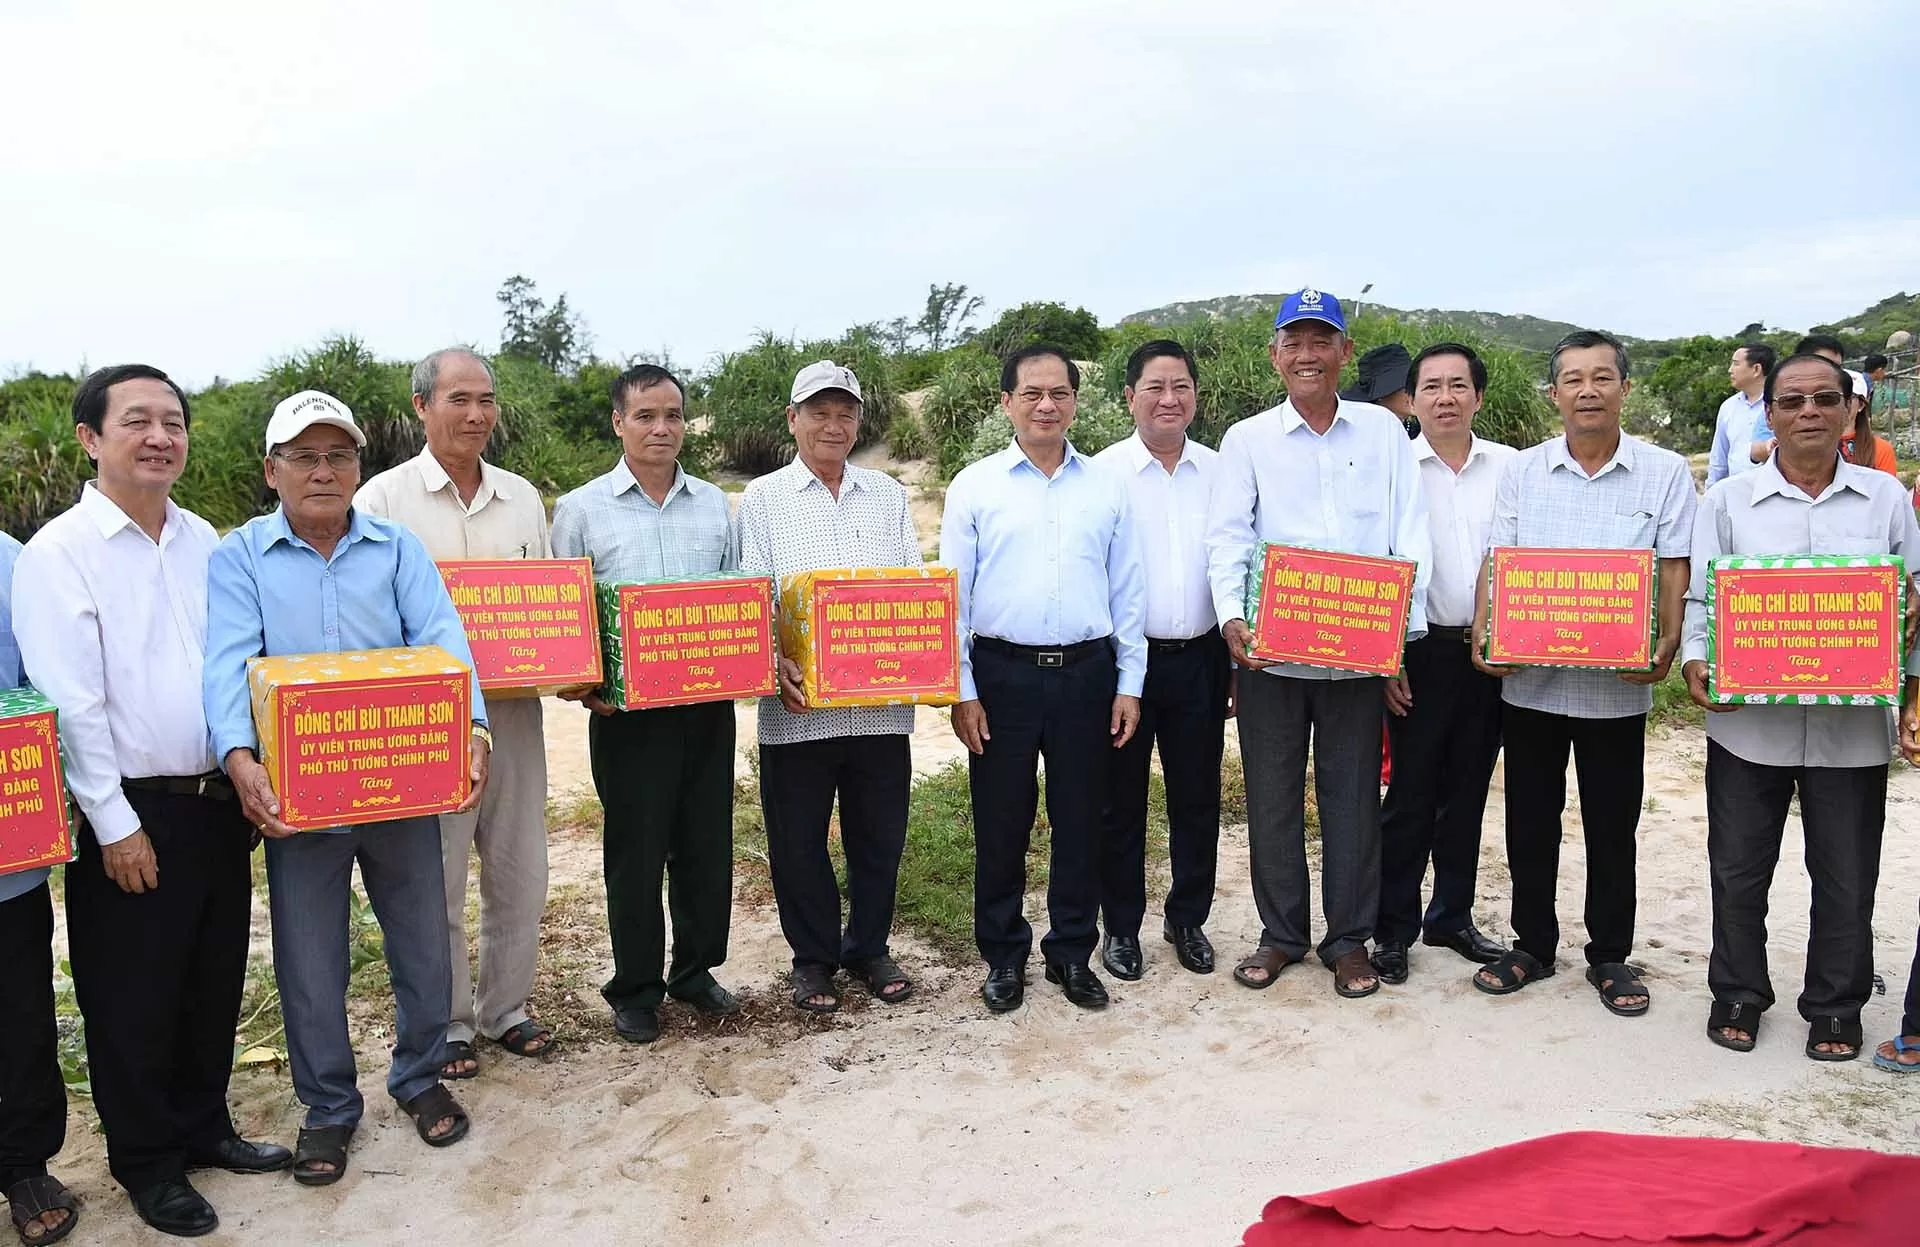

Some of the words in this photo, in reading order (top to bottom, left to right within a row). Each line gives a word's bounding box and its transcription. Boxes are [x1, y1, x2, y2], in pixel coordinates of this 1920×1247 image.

[1304, 570, 1323, 591] CHÍ
[1323, 573, 1341, 594] BÙI
[1343, 577, 1377, 598] THANH
[1378, 581, 1400, 601] SƠN
[1536, 567, 1555, 590] CHÍ
[1557, 567, 1575, 591] BÙI
[1577, 571, 1613, 591] THANH
[1615, 571, 1640, 591] SƠN
[483, 582, 501, 605] CHÍ
[503, 582, 522, 605] BÙI
[523, 584, 558, 604] THANH
[560, 582, 581, 603] SƠN
[1276, 590, 1288, 604] ỦY
[1289, 594, 1310, 607] VIÊN
[1311, 597, 1341, 610] TRUNG
[1342, 601, 1366, 614] ƯƠNG
[1367, 603, 1392, 617] ĐẢNG
[1508, 591, 1521, 605] ỦY
[1522, 592, 1544, 606] VIÊN
[1546, 595, 1577, 607] TRUNG
[1579, 595, 1605, 608] ƯƠNG
[1607, 594, 1633, 609] ĐẢNG
[1765, 589, 1786, 613] CHÍ
[1789, 588, 1810, 613] BÙI
[1813, 592, 1854, 612] THANH
[1857, 590, 1883, 612] SƠN
[473, 609, 494, 624] VIÊN
[496, 609, 527, 622] TRUNG
[529, 609, 553, 621] ƯƠNG
[555, 607, 579, 621] ĐẢNG
[665, 603, 683, 627] CHÍ
[685, 602, 703, 625] BÙI
[705, 603, 739, 621] THANH
[740, 600, 761, 621] SƠN
[855, 598, 873, 621] CHÍ
[874, 599, 891, 620] BÙI
[892, 600, 924, 620] THANH
[925, 599, 945, 619] SƠN
[1506, 609, 1526, 622] PHÓ
[1528, 608, 1546, 622] THỦ
[1549, 610, 1580, 623] TƯỚNG
[1582, 610, 1612, 623] CHÍNH
[1614, 611, 1634, 624] PHỦ
[1272, 607, 1291, 619] PHÓ
[1293, 608, 1311, 622] THỦ
[1312, 612, 1341, 626] TƯỚNG
[1343, 616, 1370, 630] CHÍNH
[1372, 618, 1391, 633] PHỦ
[1735, 617, 1748, 632] ỦY
[1751, 617, 1775, 632] VIÊN
[1778, 619, 1813, 631] TRUNG
[1815, 618, 1845, 631] ƯƠNG
[1848, 616, 1878, 631] ĐẢNG
[464, 627, 478, 641] HÓ
[480, 626, 499, 640] THỦ
[500, 626, 531, 640] TƯỚNG
[533, 625, 561, 638] CHÍNH
[563, 623, 581, 637] PHỦ
[639, 632, 652, 647] ỦY
[653, 633, 674, 645] VIÊN
[676, 631, 706, 643] TRUNG
[708, 629, 733, 641] ƯƠNG
[735, 625, 758, 638] ĐẢNG
[831, 623, 842, 639] ỦY
[843, 625, 864, 638] VIÊN
[865, 626, 893, 638] TRUNG
[895, 624, 917, 636] ƯƠNG
[919, 622, 941, 635] ĐẢNG
[1315, 629, 1343, 644] Tặng
[1553, 627, 1583, 641] Tặng
[830, 642, 848, 655] PHÓ
[850, 642, 867, 654] THỦ
[869, 641, 897, 653] TƯỚNG
[898, 639, 925, 652] CHÍNH
[926, 638, 943, 650] PHỦ
[1733, 635, 1755, 649] PHÓ
[1758, 634, 1779, 648] THỦ
[1781, 635, 1817, 649] TƯỚNG
[1819, 635, 1853, 648] CHÍNH
[1856, 633, 1879, 648] PHỦ
[639, 650, 657, 663] PHÓ
[660, 649, 679, 661] THỦ
[680, 646, 710, 660] TƯỚNG
[712, 644, 740, 657] CHÍNH
[742, 641, 760, 654] PHỦ
[1788, 654, 1822, 669] Tặng
[687, 665, 715, 676] Tặng
[874, 658, 901, 671] Tặng
[334, 705, 356, 732] CHÍ
[359, 704, 381, 730] BÙI
[384, 703, 425, 728] THANH
[428, 700, 454, 725] SƠN
[300, 740, 316, 756] ỦY
[319, 737, 345, 755] VIÊN
[348, 736, 384, 752] TRUNG
[387, 733, 417, 748] ƯƠNG
[419, 730, 449, 745] ĐẢNG
[10, 743, 43, 772] SƠN
[299, 758, 323, 775] PHÓ
[326, 758, 349, 774] THỦ
[352, 754, 388, 771] TƯỚNG
[391, 751, 425, 766] CHÍNH
[428, 745, 450, 762] PHỦ
[3, 777, 40, 796] ĐẢNG
[359, 776, 393, 790] Tặng
[16, 794, 44, 815] PHỦ
